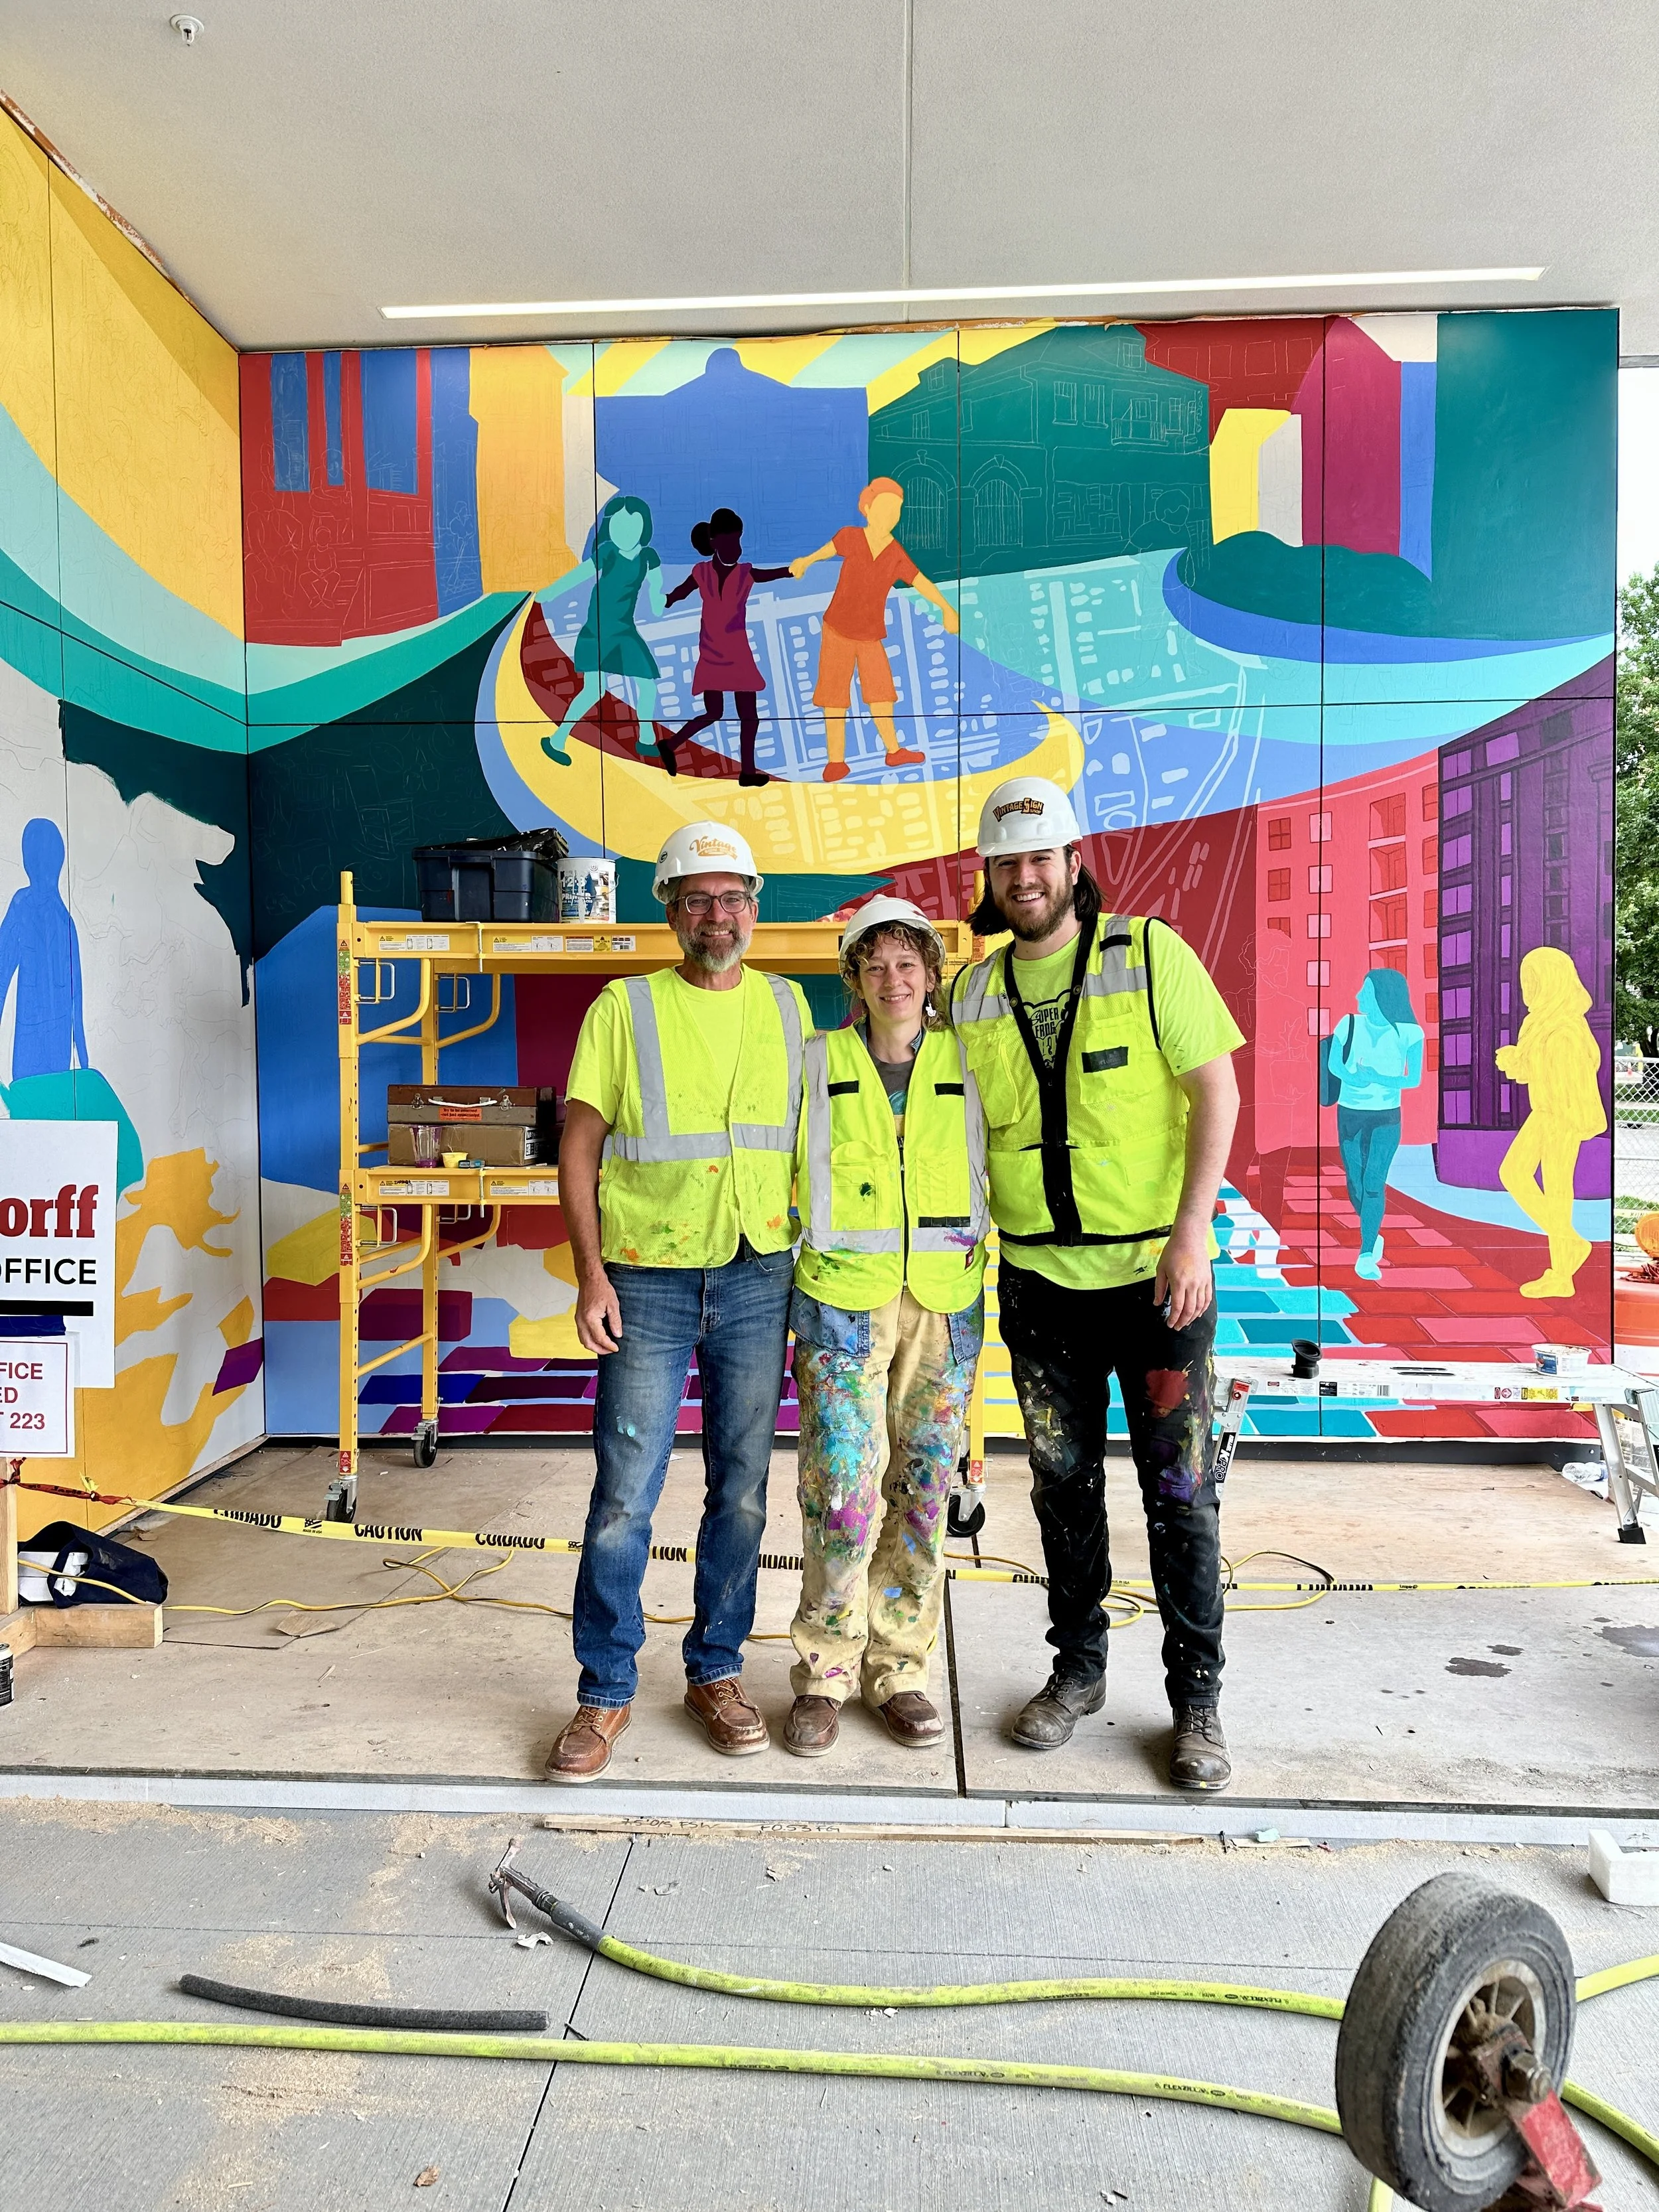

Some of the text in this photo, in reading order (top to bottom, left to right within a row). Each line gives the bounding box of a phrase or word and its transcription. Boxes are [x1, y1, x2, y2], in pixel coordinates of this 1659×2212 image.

[993, 798, 1043, 821] VINTAGE SIGN
[689, 836, 737, 853] Vintage
[1031, 1007, 1059, 1026] SUPER
[1035, 1021, 1057, 1038] FROG
[0, 1184, 98, 1238] orff
[0, 1258, 97, 1284] FFICE
[10, 1412, 45, 1430] 223
[354, 1524, 423, 1541] CAUTION
[1163, 2083, 1206, 2094] FLEXZILLA
